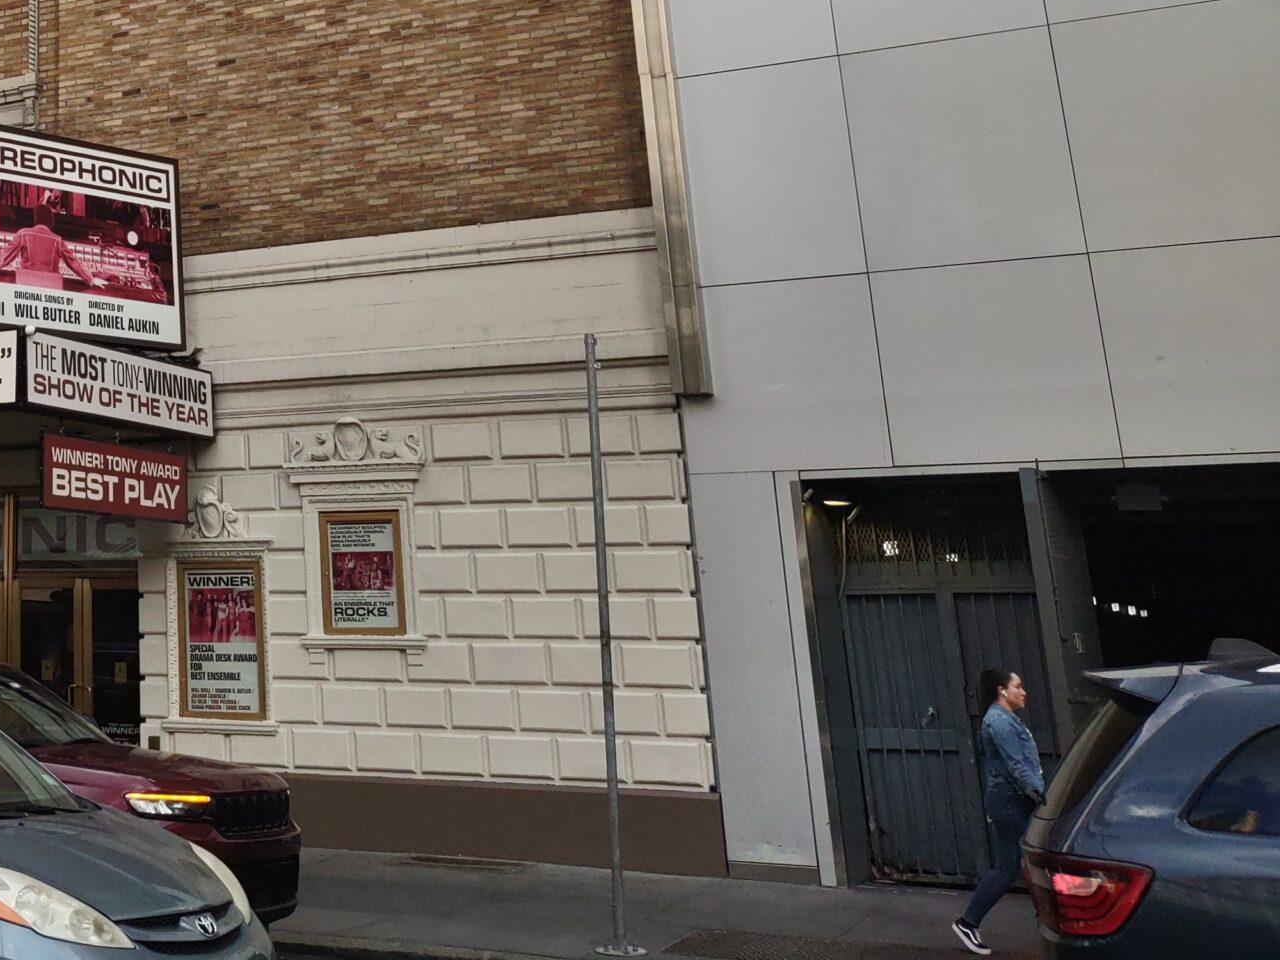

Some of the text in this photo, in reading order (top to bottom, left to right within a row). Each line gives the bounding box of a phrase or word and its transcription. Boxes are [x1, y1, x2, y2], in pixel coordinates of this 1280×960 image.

[14, 290, 74, 306] ORIGINAL SONGS BY
[14, 303, 81, 325] WILL BUTLER
[88, 300, 124, 313] DIRECTED BY
[89, 312, 160, 335] DANIEL AUKIN
[32, 341, 207, 405] THE MOST TONY-WINNING
[33, 373, 209, 427] SHOW OF THE YEAR
[52, 446, 180, 480] WINNER! TONY AWARD
[52, 468, 181, 510] BEST PLAY
[188, 576, 255, 587] WINNER!
[190, 644, 215, 653] SPECIAL
[190, 654, 257, 662] DRAMA DESK AWARD
[190, 663, 202, 671] FOR
[191, 672, 241, 681] BEST ENSEMBLE
